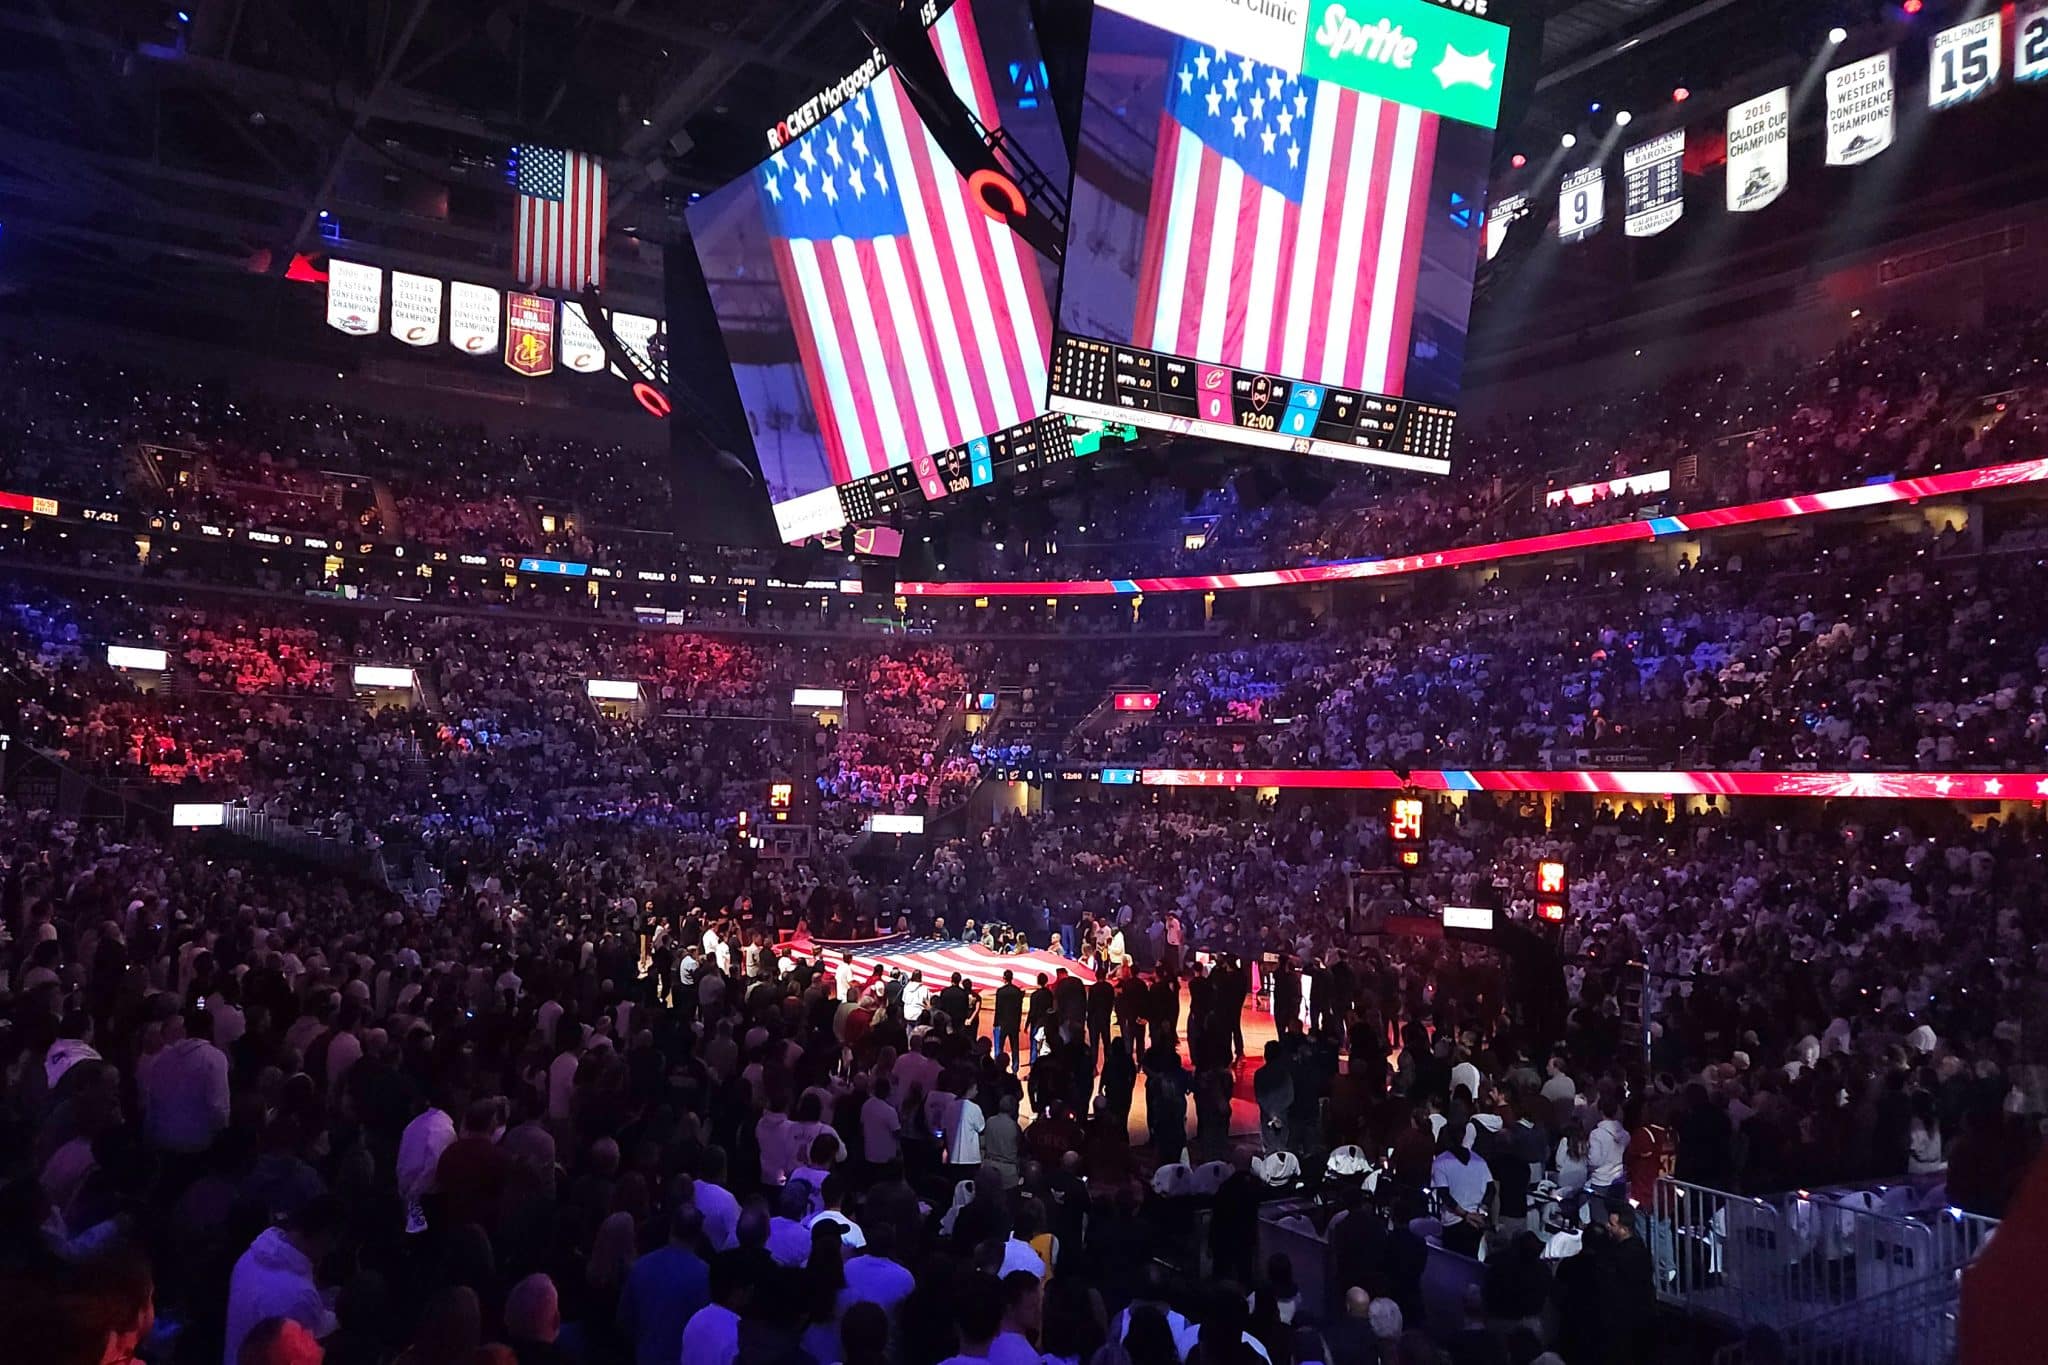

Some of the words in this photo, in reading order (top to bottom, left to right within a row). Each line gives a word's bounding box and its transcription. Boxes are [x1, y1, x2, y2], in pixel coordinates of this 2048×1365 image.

[1315, 3, 1418, 69] Sprite
[1836, 60, 1886, 88] 2015-16
[1941, 36, 1988, 94] 15
[818, 58, 876, 115] Mortgage
[1838, 78, 1885, 103] WESTERN
[1745, 101, 1772, 121] 2016
[1830, 88, 1895, 121] CONFERENCE
[1729, 120, 1766, 143] CALDER
[1768, 111, 1788, 130] CUP
[1832, 105, 1890, 135] CHAMPIONS
[1729, 127, 1787, 158] CHAMPIONS
[1635, 144, 1673, 164] BARONS
[1560, 167, 1602, 191] GLOVER
[1574, 190, 1588, 225] 9
[333, 298, 376, 314] CHAMPIONS
[395, 310, 436, 324] CHAMPIONS
[1210, 398, 1221, 417] 0
[1241, 411, 1275, 430] 12:00
[1293, 413, 1305, 432] 0
[948, 476, 970, 493] 12:00
[82, 509, 119, 523] $7,421
[172, 521, 181, 531] 0
[227, 528, 235, 538] 7
[284, 535, 292, 545] 0
[335, 540, 343, 550] 0
[395, 546, 404, 557] 0
[434, 552, 448, 561] 24
[500, 557, 515, 568] 1Q
[616, 569, 623, 578] 0
[670, 573, 677, 582] 0
[710, 575, 717, 585] 7
